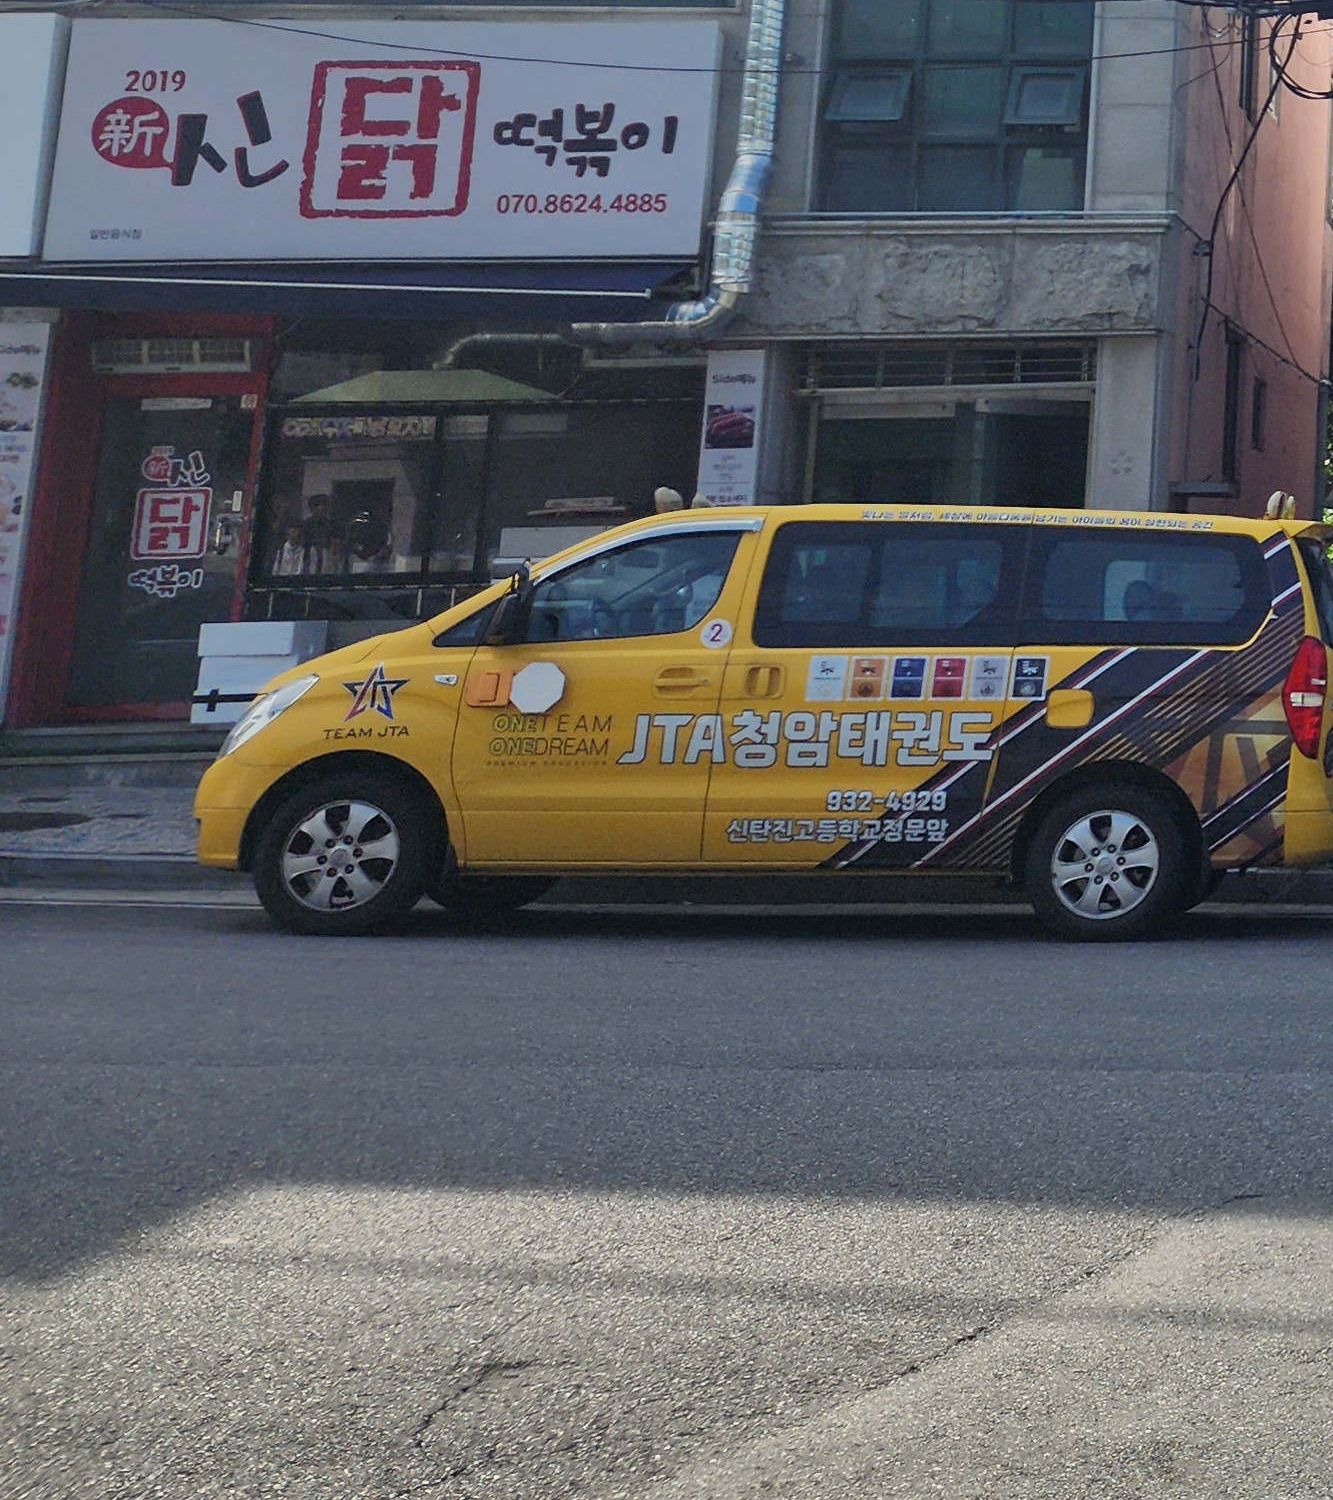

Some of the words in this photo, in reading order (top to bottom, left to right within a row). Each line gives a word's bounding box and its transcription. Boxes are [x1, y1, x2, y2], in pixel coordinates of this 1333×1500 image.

[125, 70, 187, 93] 2019
[99, 107, 164, 158] 新
[493, 101, 679, 178] 떡볶이
[496, 193, 668, 215] 070.8624.4885
[709, 621, 723, 643] 2
[323, 726, 374, 741] TEAM
[377, 724, 410, 740] JTA
[826, 790, 948, 813] 932-4929
